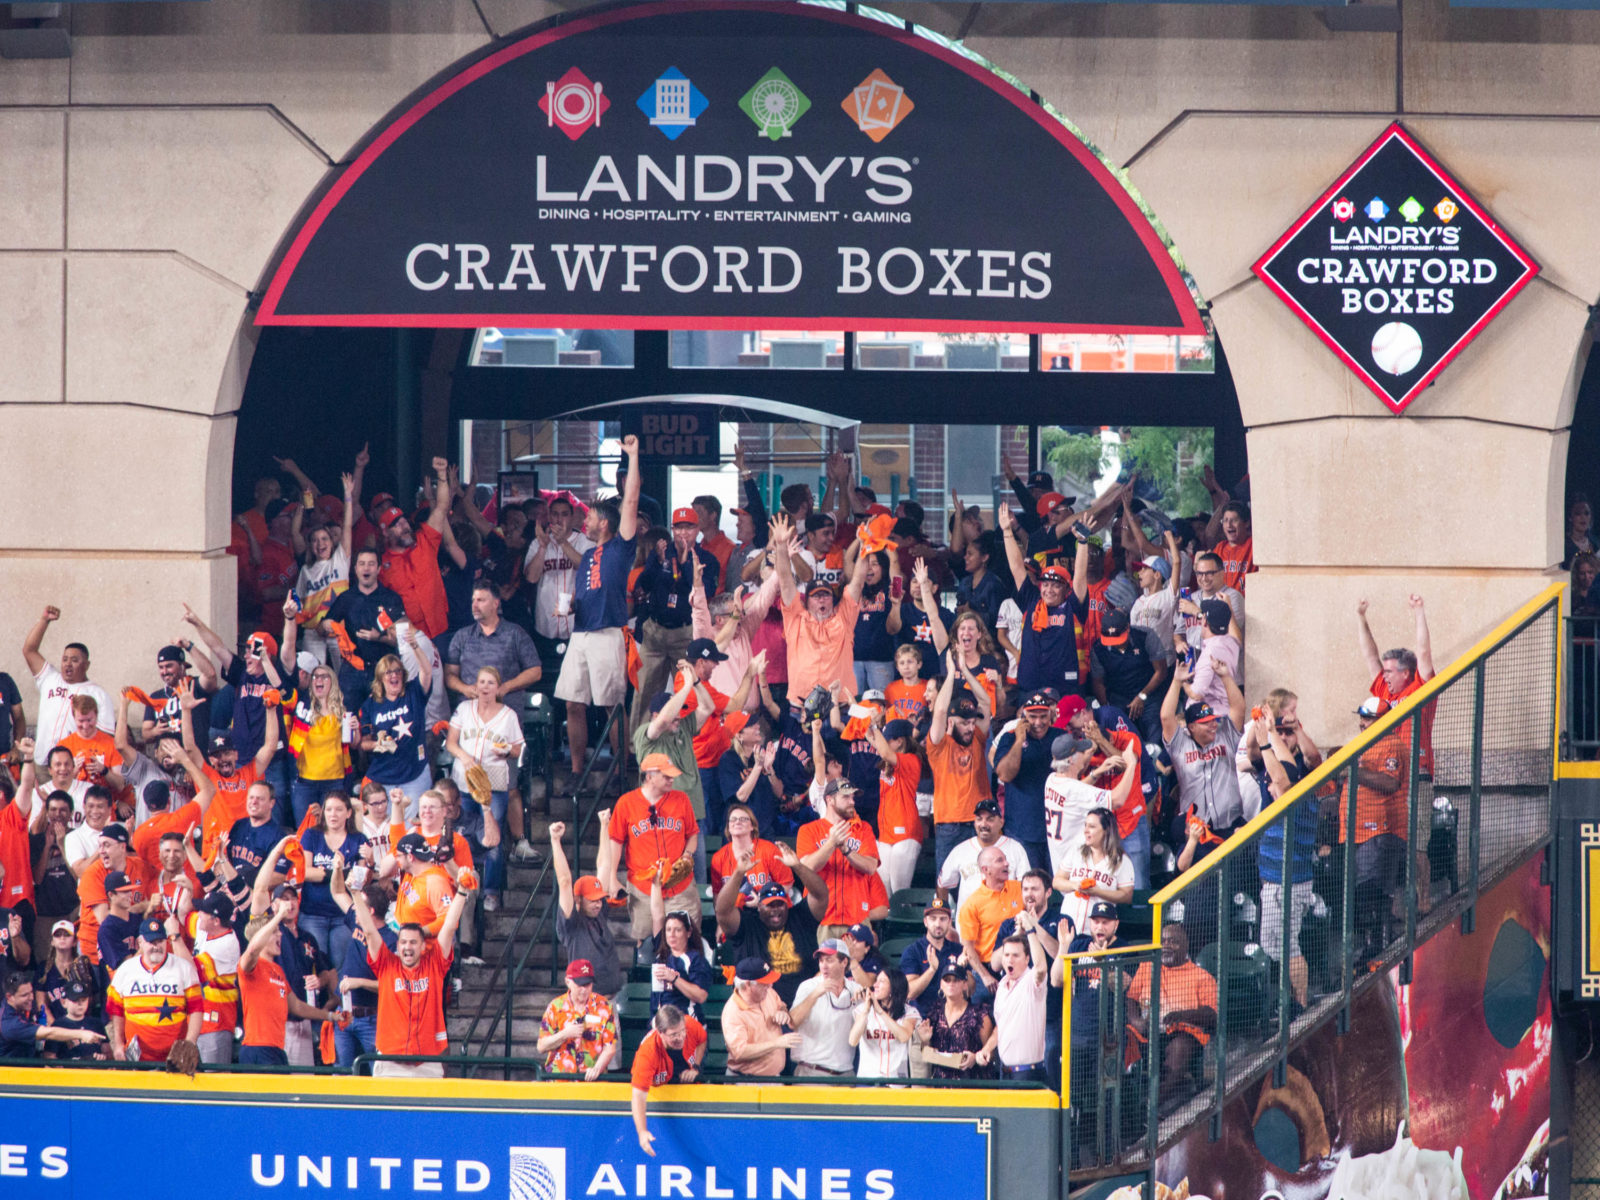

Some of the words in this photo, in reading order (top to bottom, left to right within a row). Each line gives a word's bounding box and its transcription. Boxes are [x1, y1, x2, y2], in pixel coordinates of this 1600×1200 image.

[536, 155, 914, 204] LANDRY'S
[538, 208, 590, 220] DINING
[602, 209, 702, 221] HOSPITALITY
[713, 210, 840, 223] ENTERTAINMENT
[851, 211, 912, 224] GAMING
[1330, 226, 1459, 244] LANDRY'S
[405, 242, 803, 294] CRAWFORD
[836, 246, 1052, 300] BOXES
[1297, 258, 1497, 284] CRAWFORD
[1341, 287, 1454, 314] BOXES
[641, 414, 699, 434] BUD
[375, 704, 409, 725] Astros
[1072, 867, 1115, 887] ASTROS
[130, 981, 179, 995] Astros
[251, 1153, 491, 1192] UNITED
[586, 1163, 895, 1200] AIRLINES
